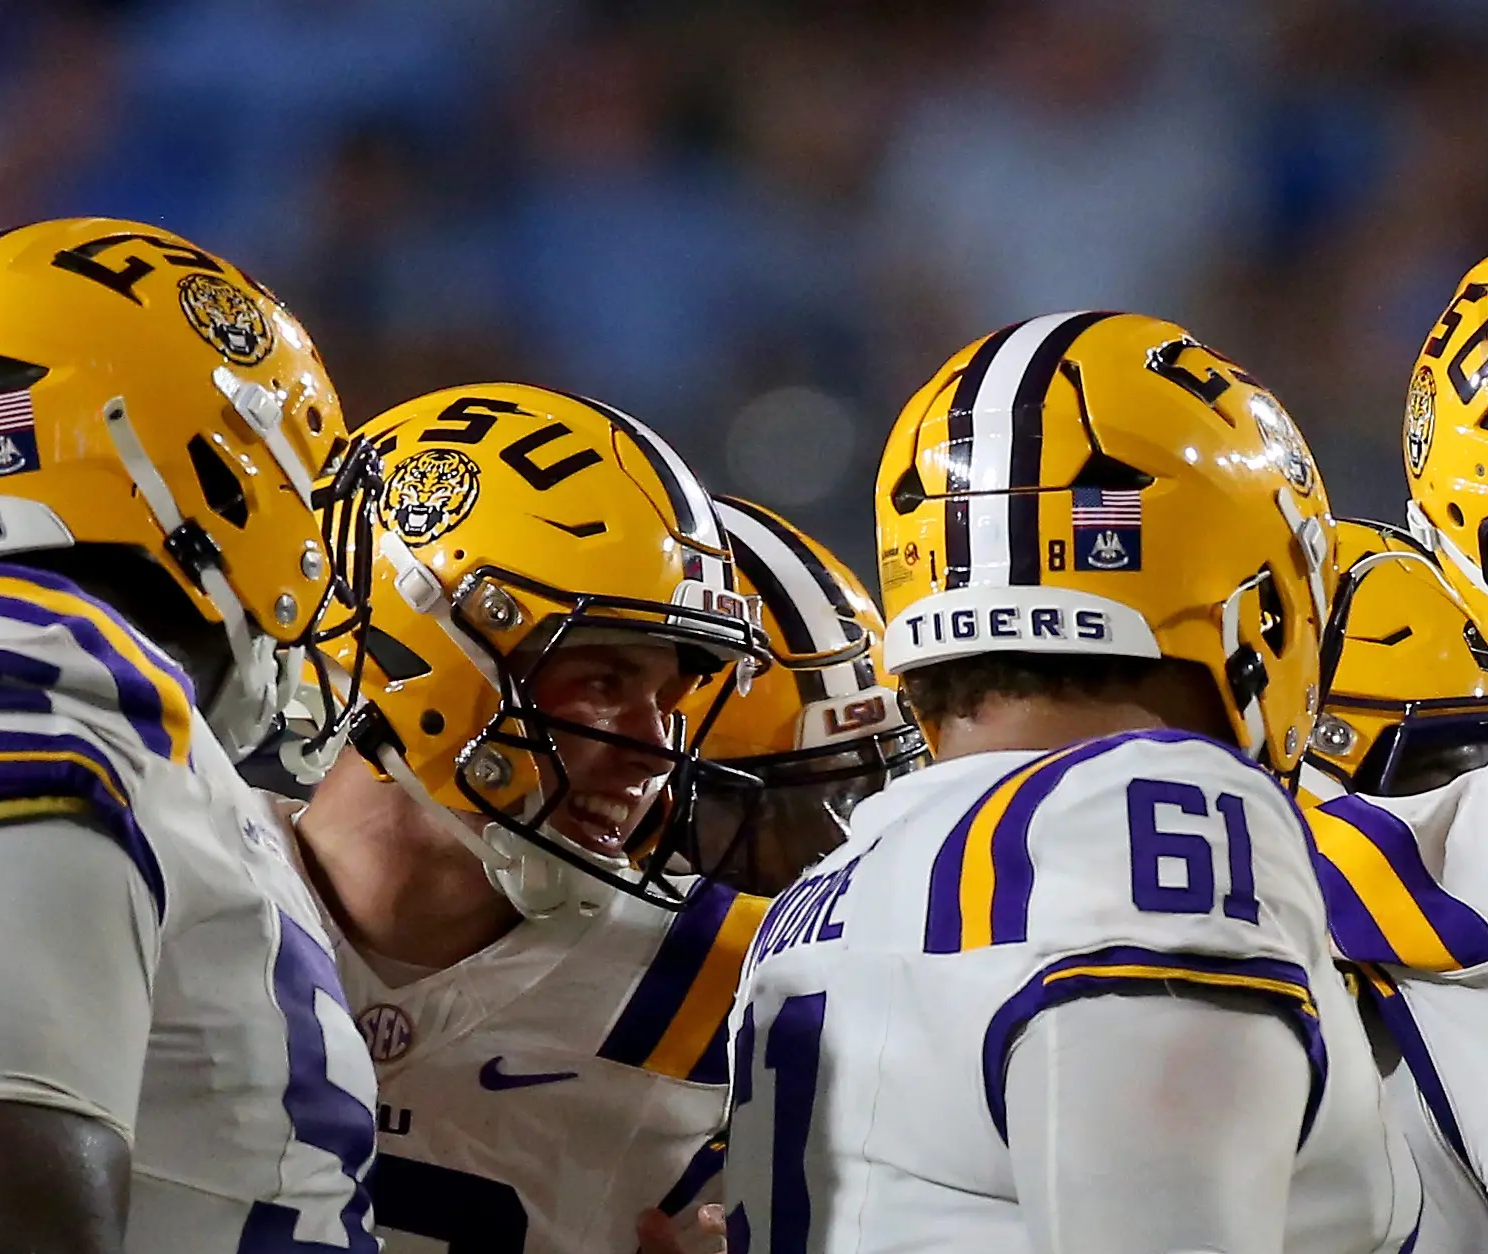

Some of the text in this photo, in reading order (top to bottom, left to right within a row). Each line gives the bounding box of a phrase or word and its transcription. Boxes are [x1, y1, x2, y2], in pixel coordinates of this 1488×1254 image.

[1048, 539, 1066, 572] 8
[906, 607, 1107, 646] TIGERS
[823, 696, 887, 736] LSU
[1125, 778, 1259, 924] 61
[359, 1006, 411, 1060] SEC
